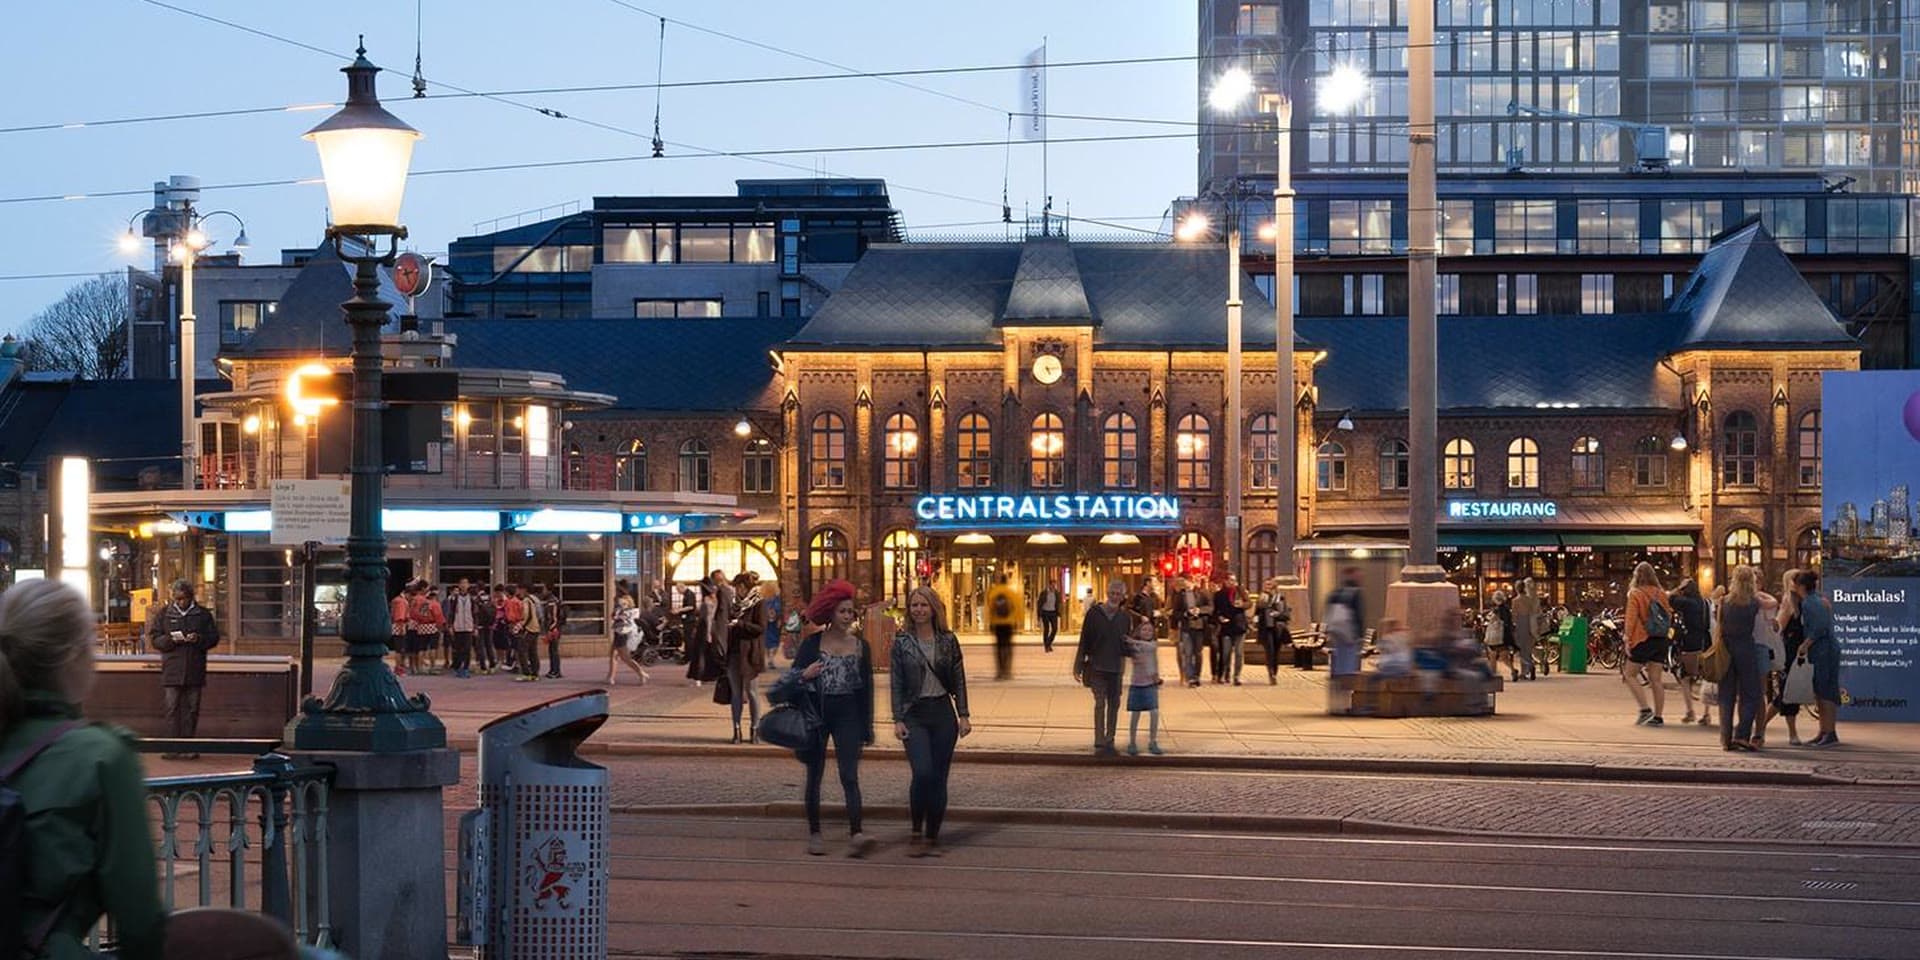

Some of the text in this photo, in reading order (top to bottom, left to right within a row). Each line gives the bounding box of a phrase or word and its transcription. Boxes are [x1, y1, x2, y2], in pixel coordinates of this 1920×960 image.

[917, 496, 1180, 519] CENTRALSTATION
[1449, 502, 1557, 516] RESTAURANG
[1833, 589, 1905, 602] Barnkalas!
